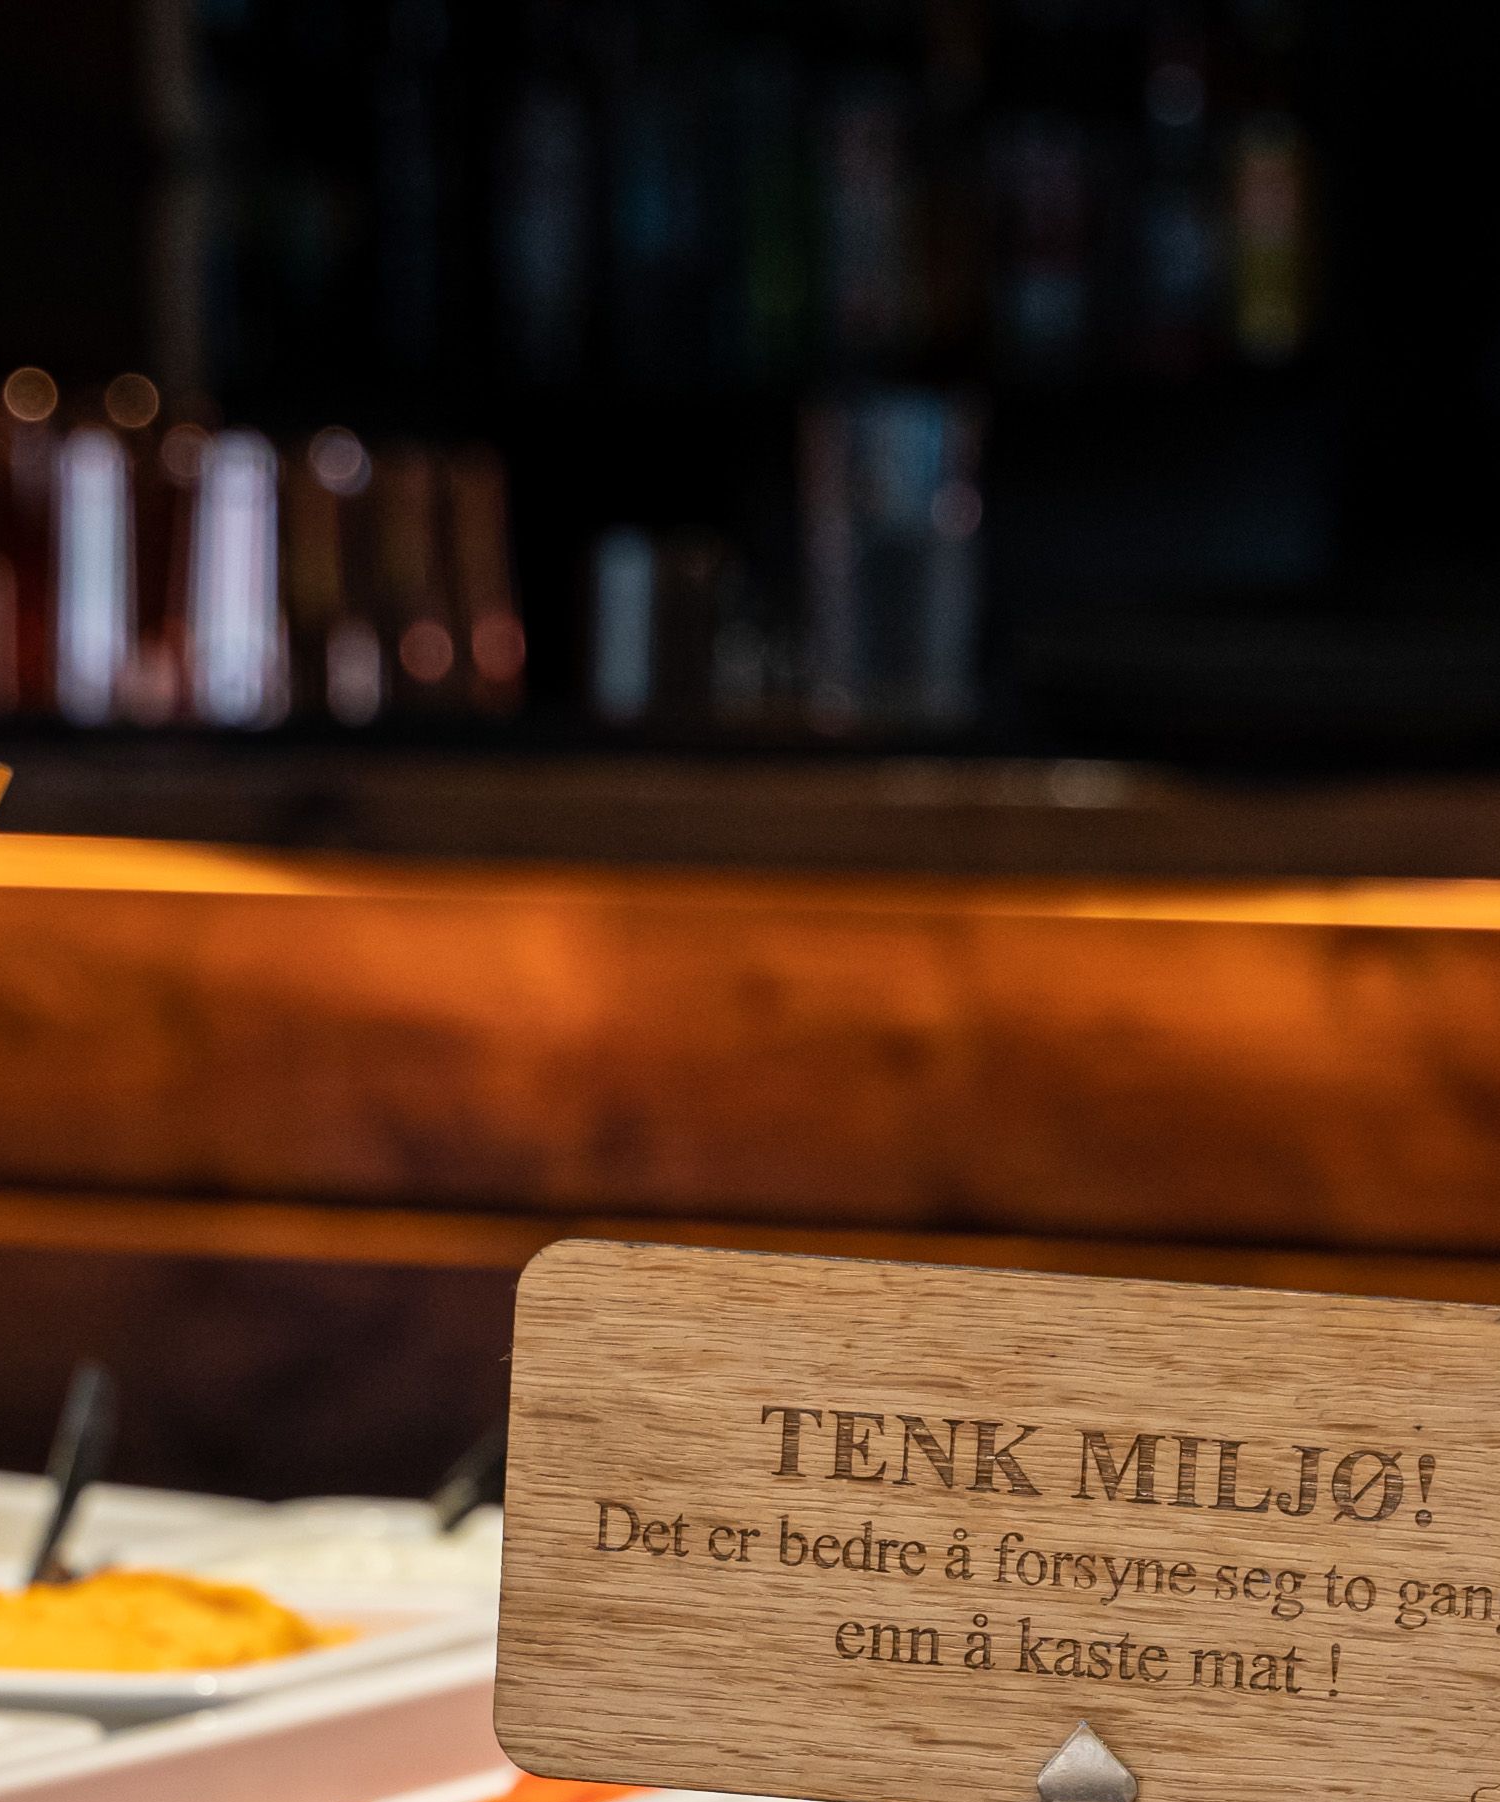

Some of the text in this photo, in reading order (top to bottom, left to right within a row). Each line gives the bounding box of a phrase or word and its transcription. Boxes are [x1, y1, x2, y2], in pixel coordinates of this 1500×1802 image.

[761, 1403, 1437, 1528] TENK MILJØ!
[596, 1499, 691, 1560] Det
[707, 1520, 762, 1563] er
[777, 1513, 927, 1577] bedre
[943, 1524, 974, 1582] å
[994, 1531, 1196, 1605] forsyne
[1214, 1559, 1303, 1619] seg
[1323, 1556, 1376, 1610] to
[834, 1611, 1343, 1698] enn å kaste mat !
